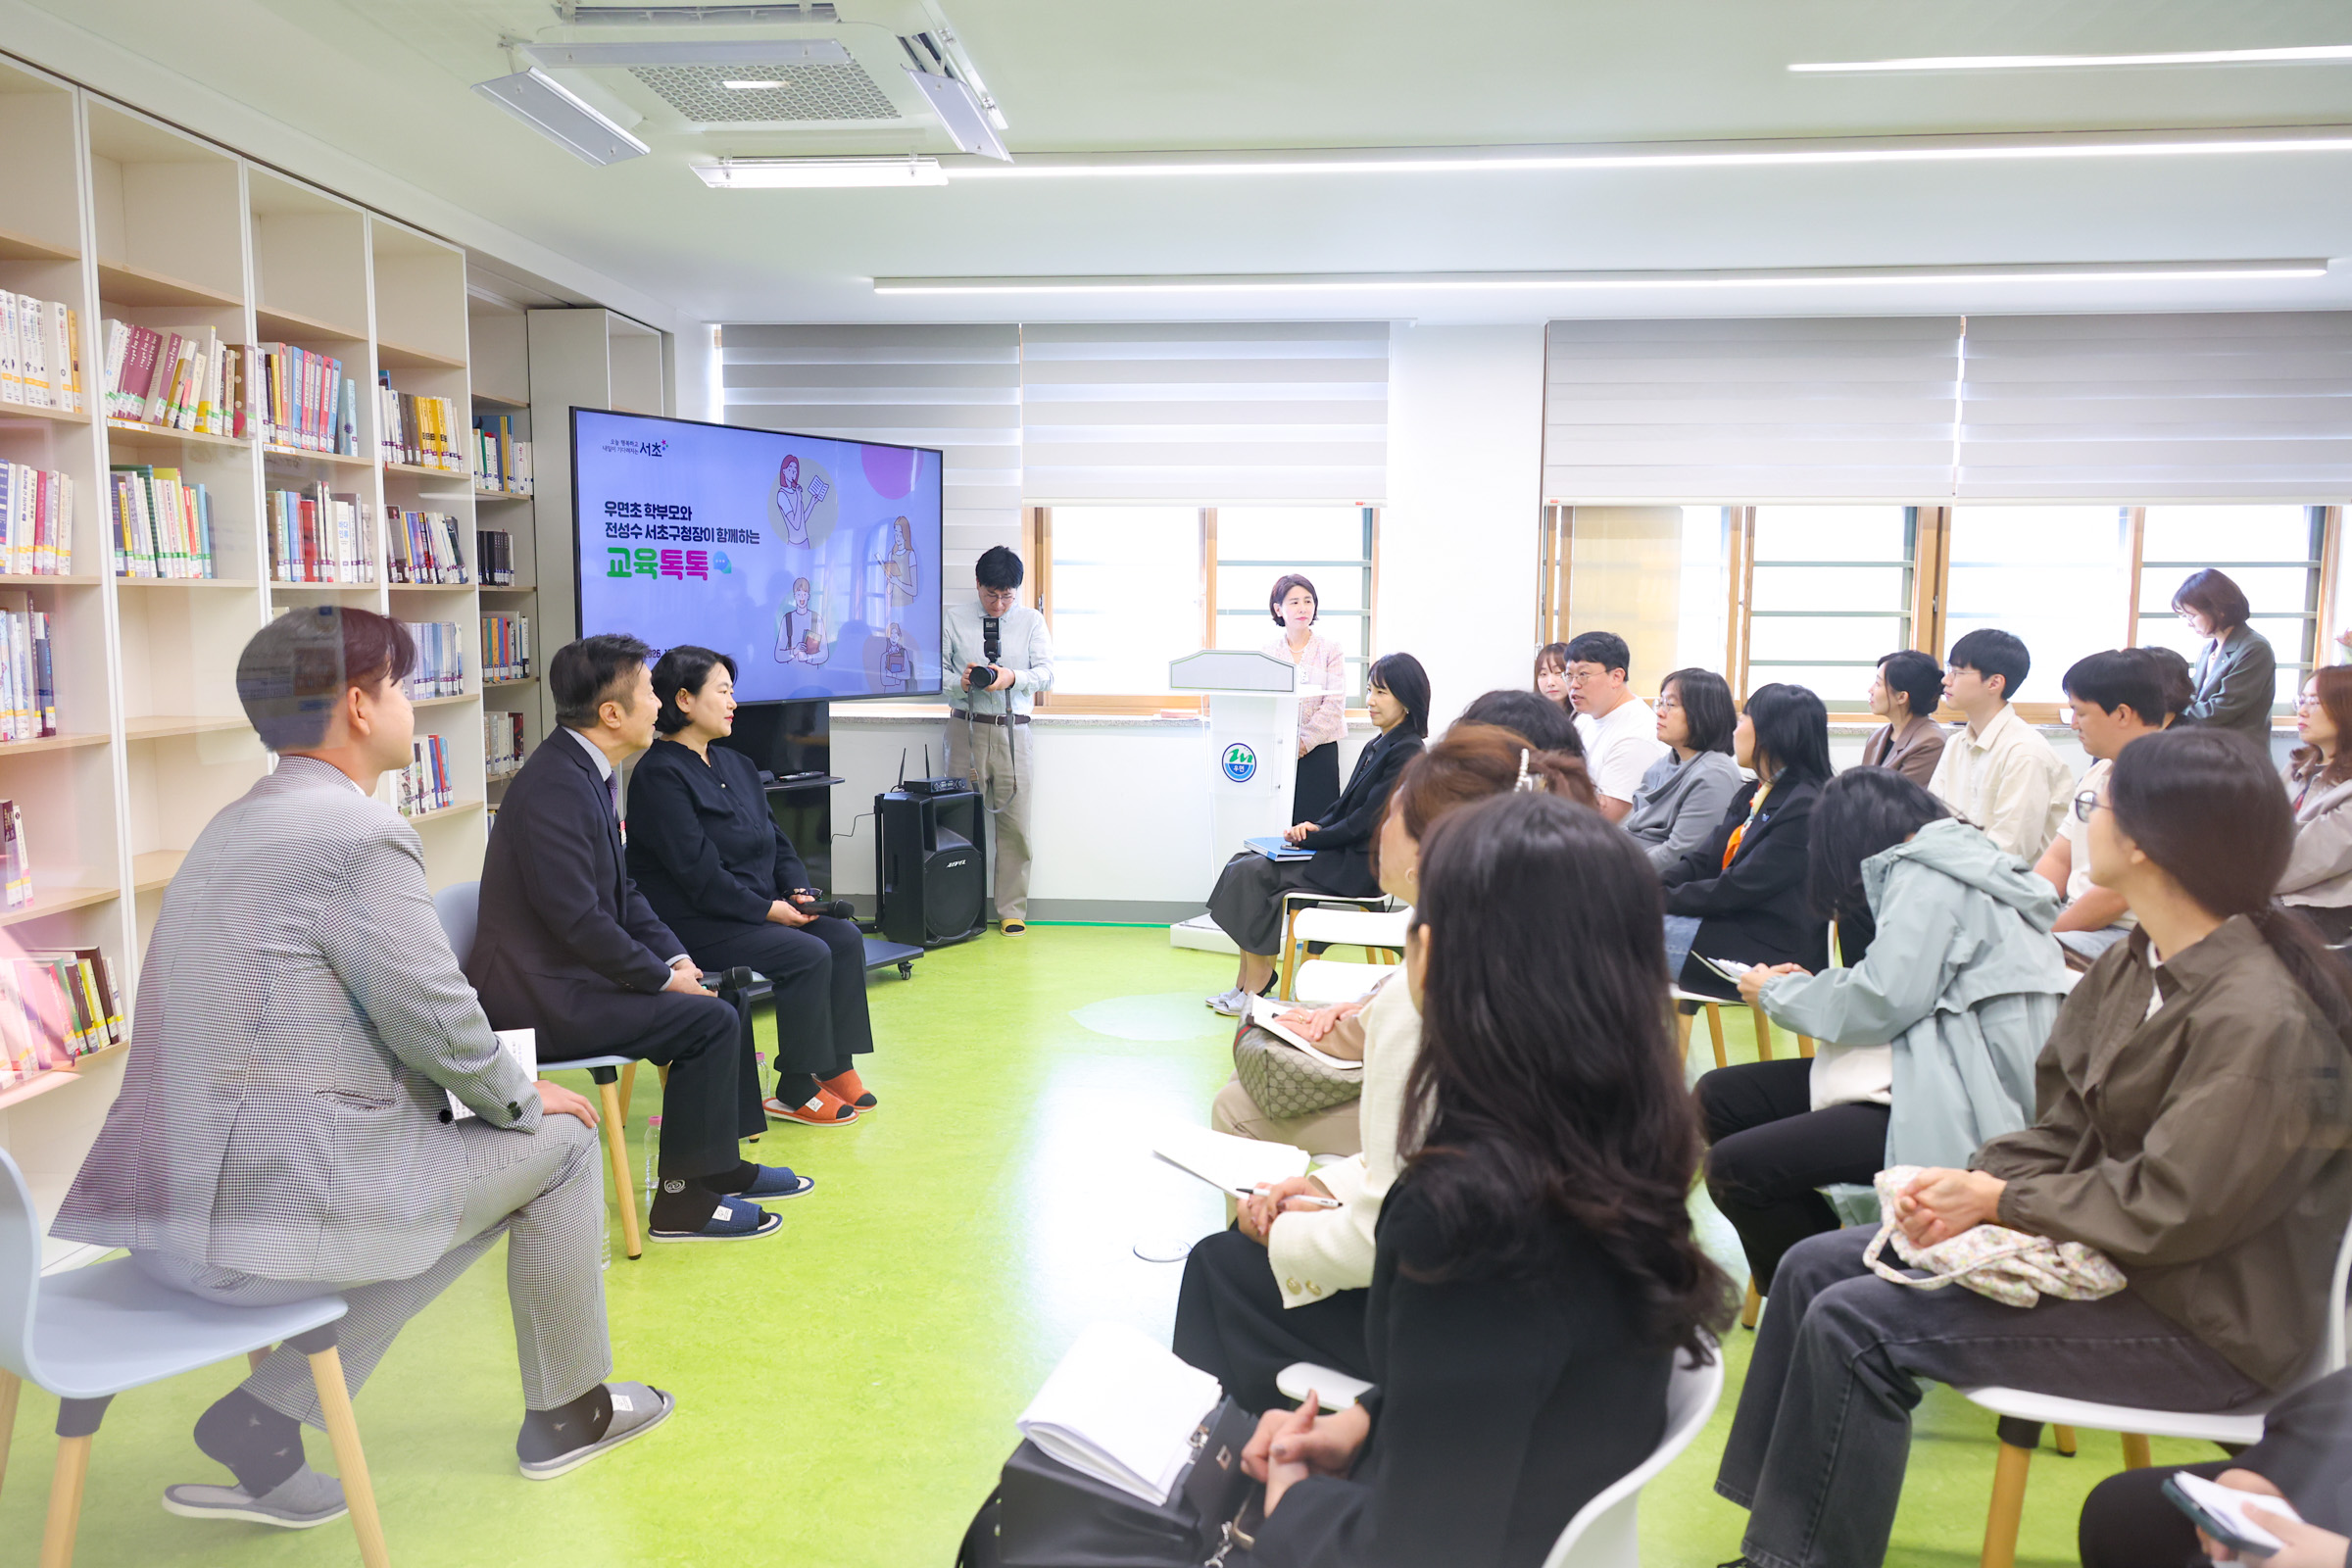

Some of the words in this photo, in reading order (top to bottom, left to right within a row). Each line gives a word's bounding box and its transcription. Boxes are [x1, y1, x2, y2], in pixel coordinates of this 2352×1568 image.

[639, 442, 662, 458] 서초
[604, 501, 643, 518] 우면초
[644, 503, 693, 521] 학부모와
[605, 521, 643, 540] 전성수
[645, 524, 715, 543] 서초구청장이
[716, 527, 760, 545] 함께하는
[607, 547, 709, 581] 교육톡톡
[1233, 764, 1245, 773] 우면
